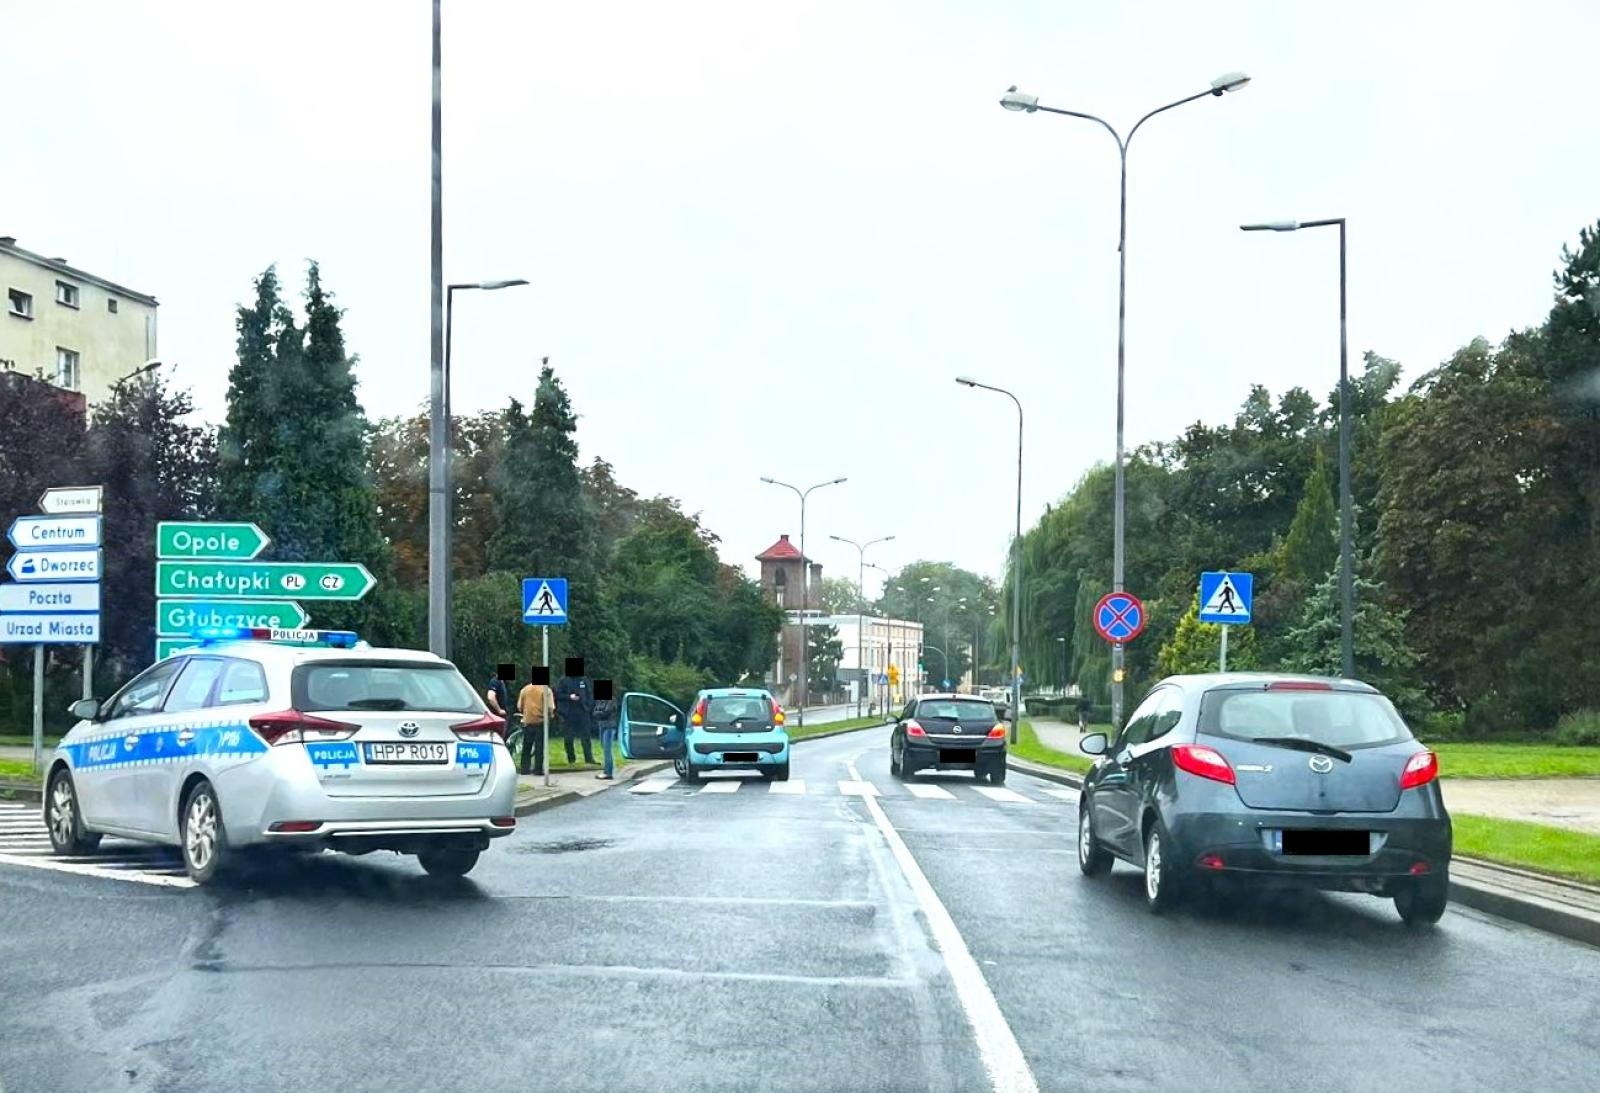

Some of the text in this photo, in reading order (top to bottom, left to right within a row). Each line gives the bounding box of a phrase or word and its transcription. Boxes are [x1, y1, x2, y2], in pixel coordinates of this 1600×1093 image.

[31, 525, 85, 540] Centrum
[172, 531, 240, 554] Opole
[41, 557, 94, 572] Dworzec
[170, 569, 339, 594] Chałupki PL CZ
[29, 590, 72, 605] Poczta
[168, 608, 281, 628] Głubczyce
[49, 621, 94, 636] Miasta
[272, 630, 316, 641] POLICJA
[313, 750, 356, 760] POLICJA
[373, 744, 445, 760] HPP R019
